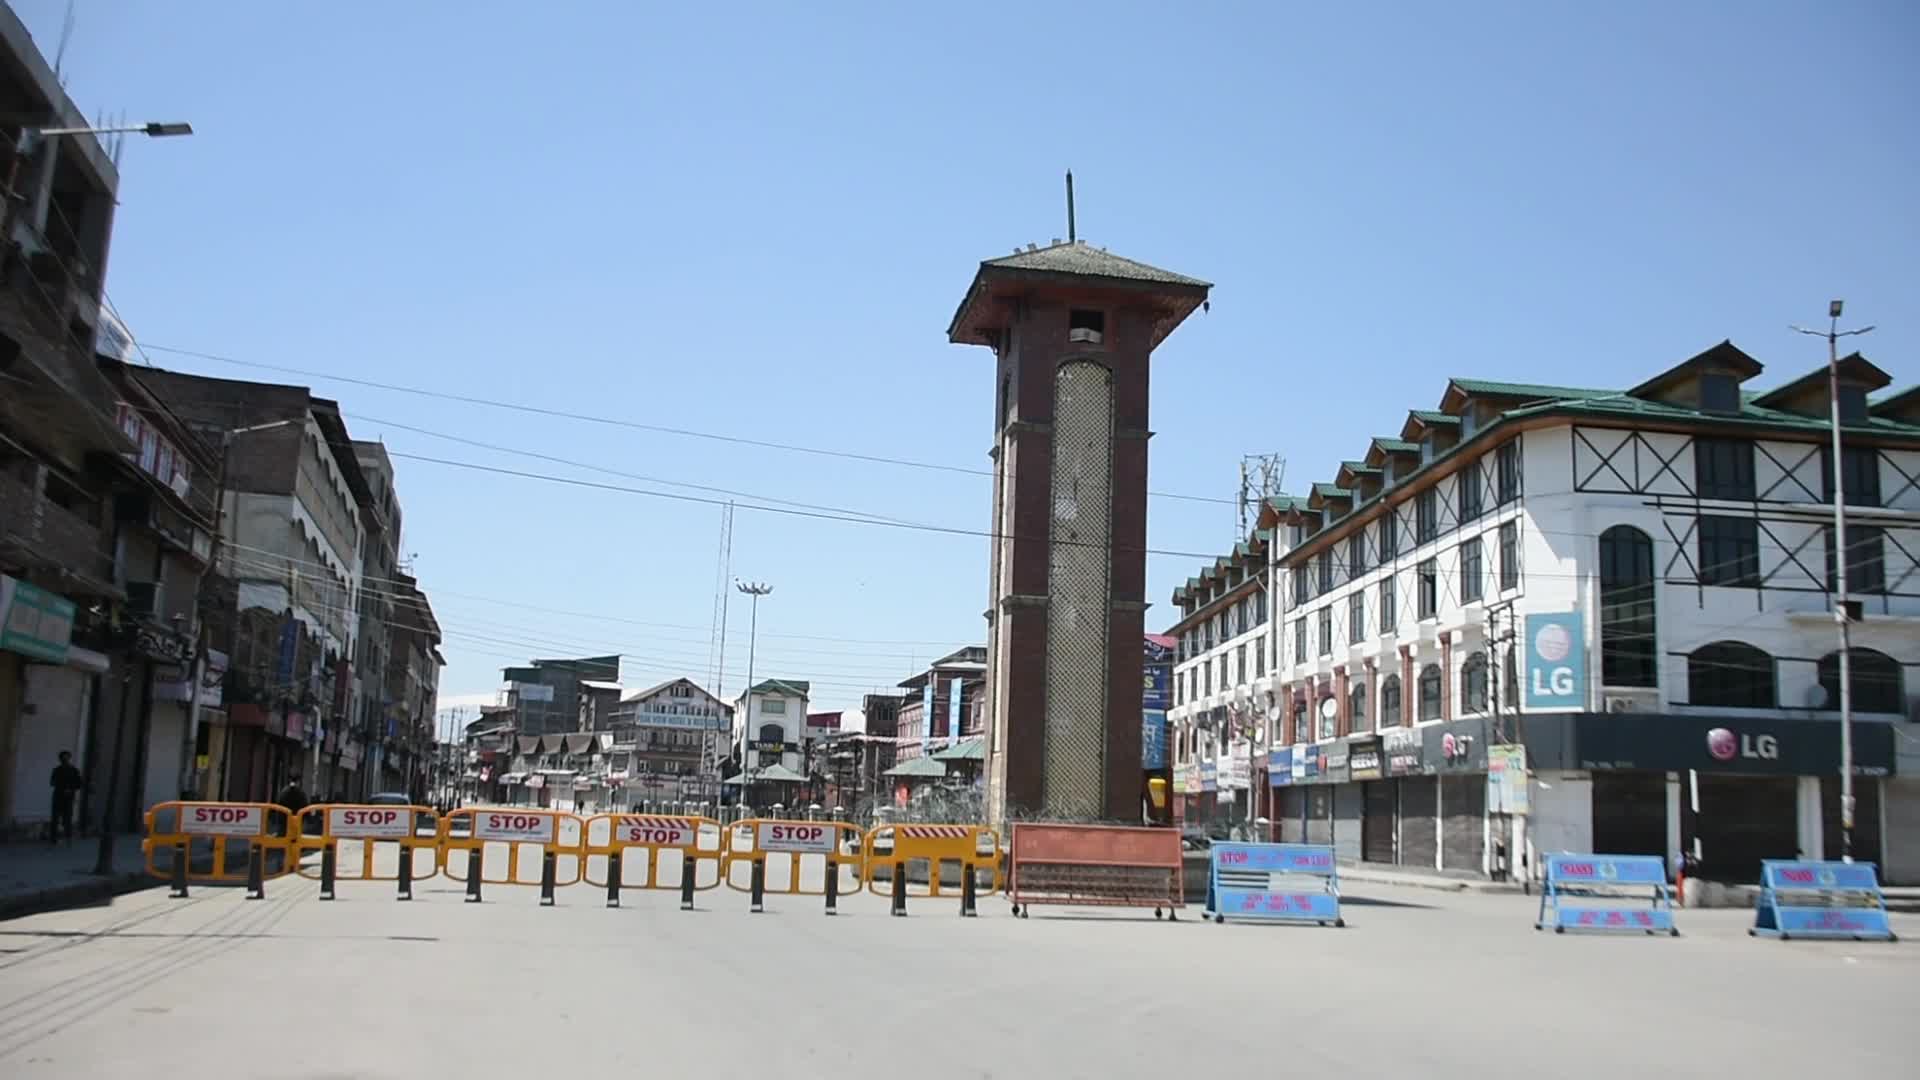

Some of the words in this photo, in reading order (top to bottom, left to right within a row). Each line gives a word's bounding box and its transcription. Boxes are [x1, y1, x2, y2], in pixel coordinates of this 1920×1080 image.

[1533, 666, 1574, 696] LG
[1741, 734, 1779, 759] LG
[195, 808, 248, 823] STOP
[344, 811, 397, 825] STOP
[489, 814, 541, 830] STOP
[629, 828, 682, 844] STOP
[772, 825, 823, 841] STOP
